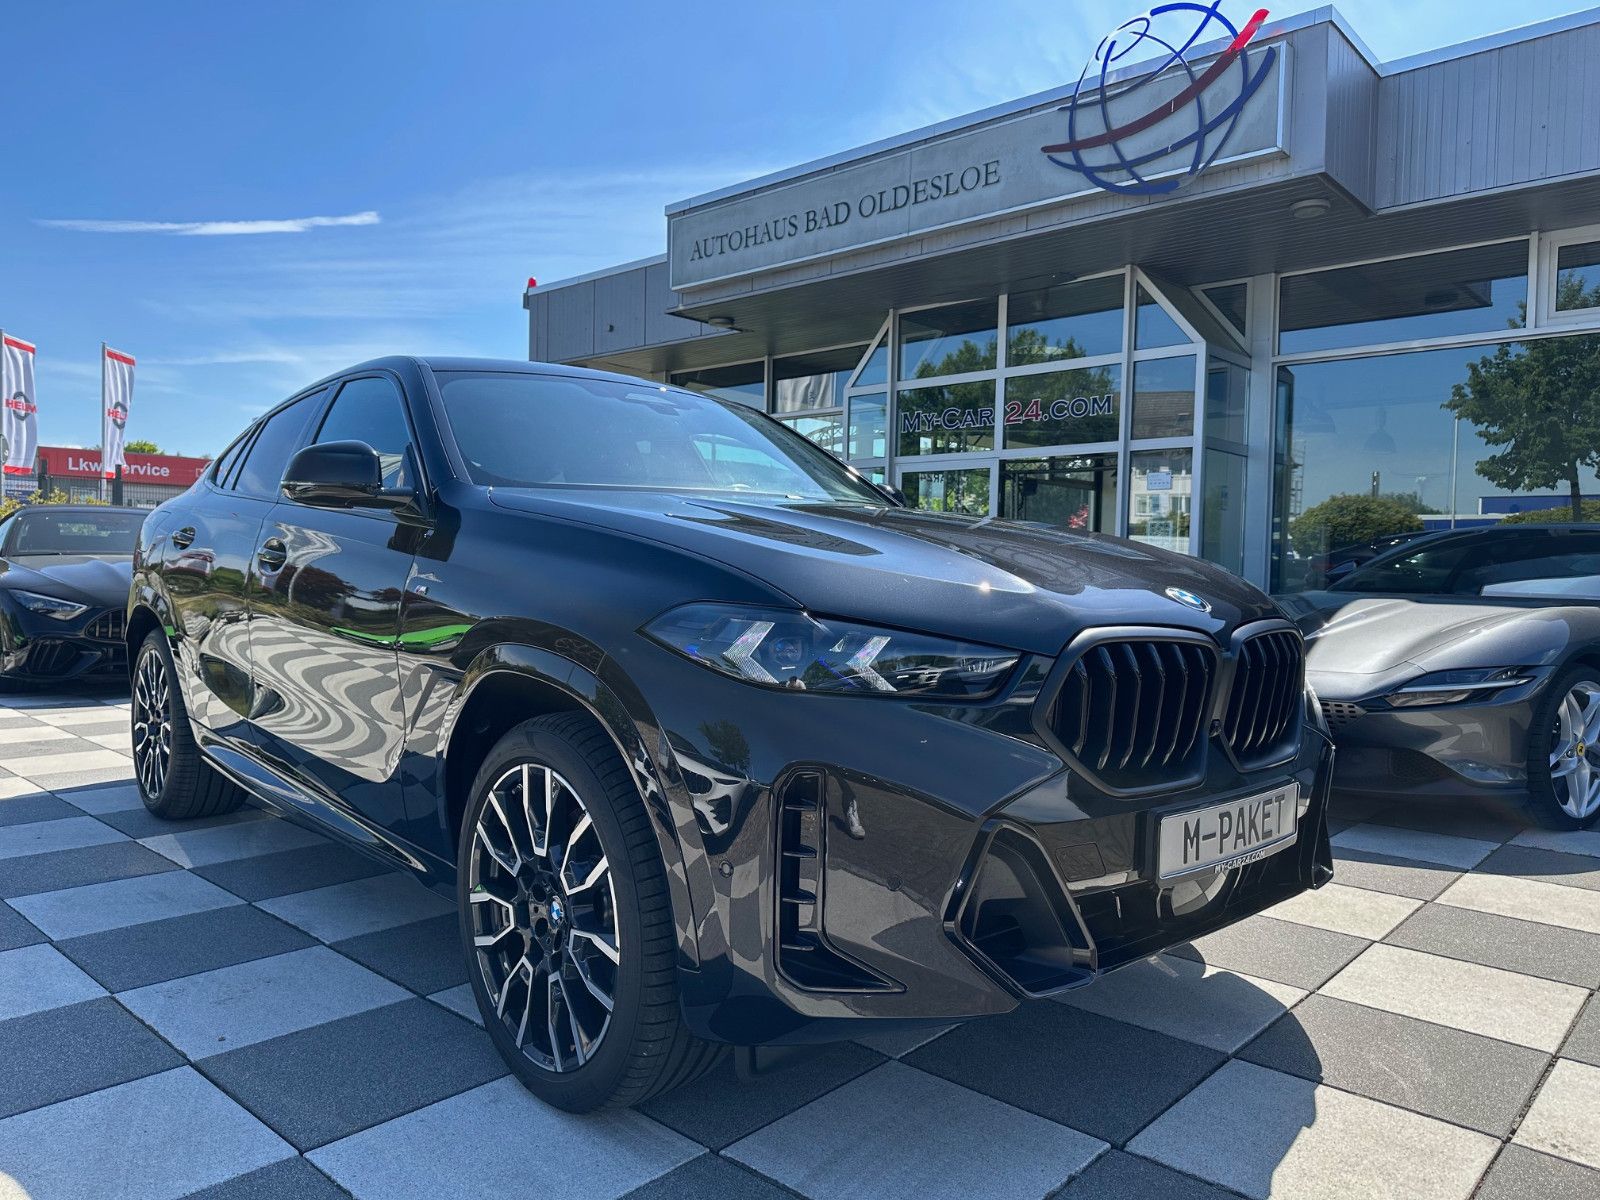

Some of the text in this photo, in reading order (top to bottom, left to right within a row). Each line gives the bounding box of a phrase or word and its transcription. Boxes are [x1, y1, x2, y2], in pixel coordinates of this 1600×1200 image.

[689, 160, 1001, 262] AUTOHAUS BAD OLDESLOE
[122, 461, 170, 477] ervice
[1183, 794, 1285, 864] M-PAKET
[1213, 850, 1266, 873] MY-CAR24.COM
